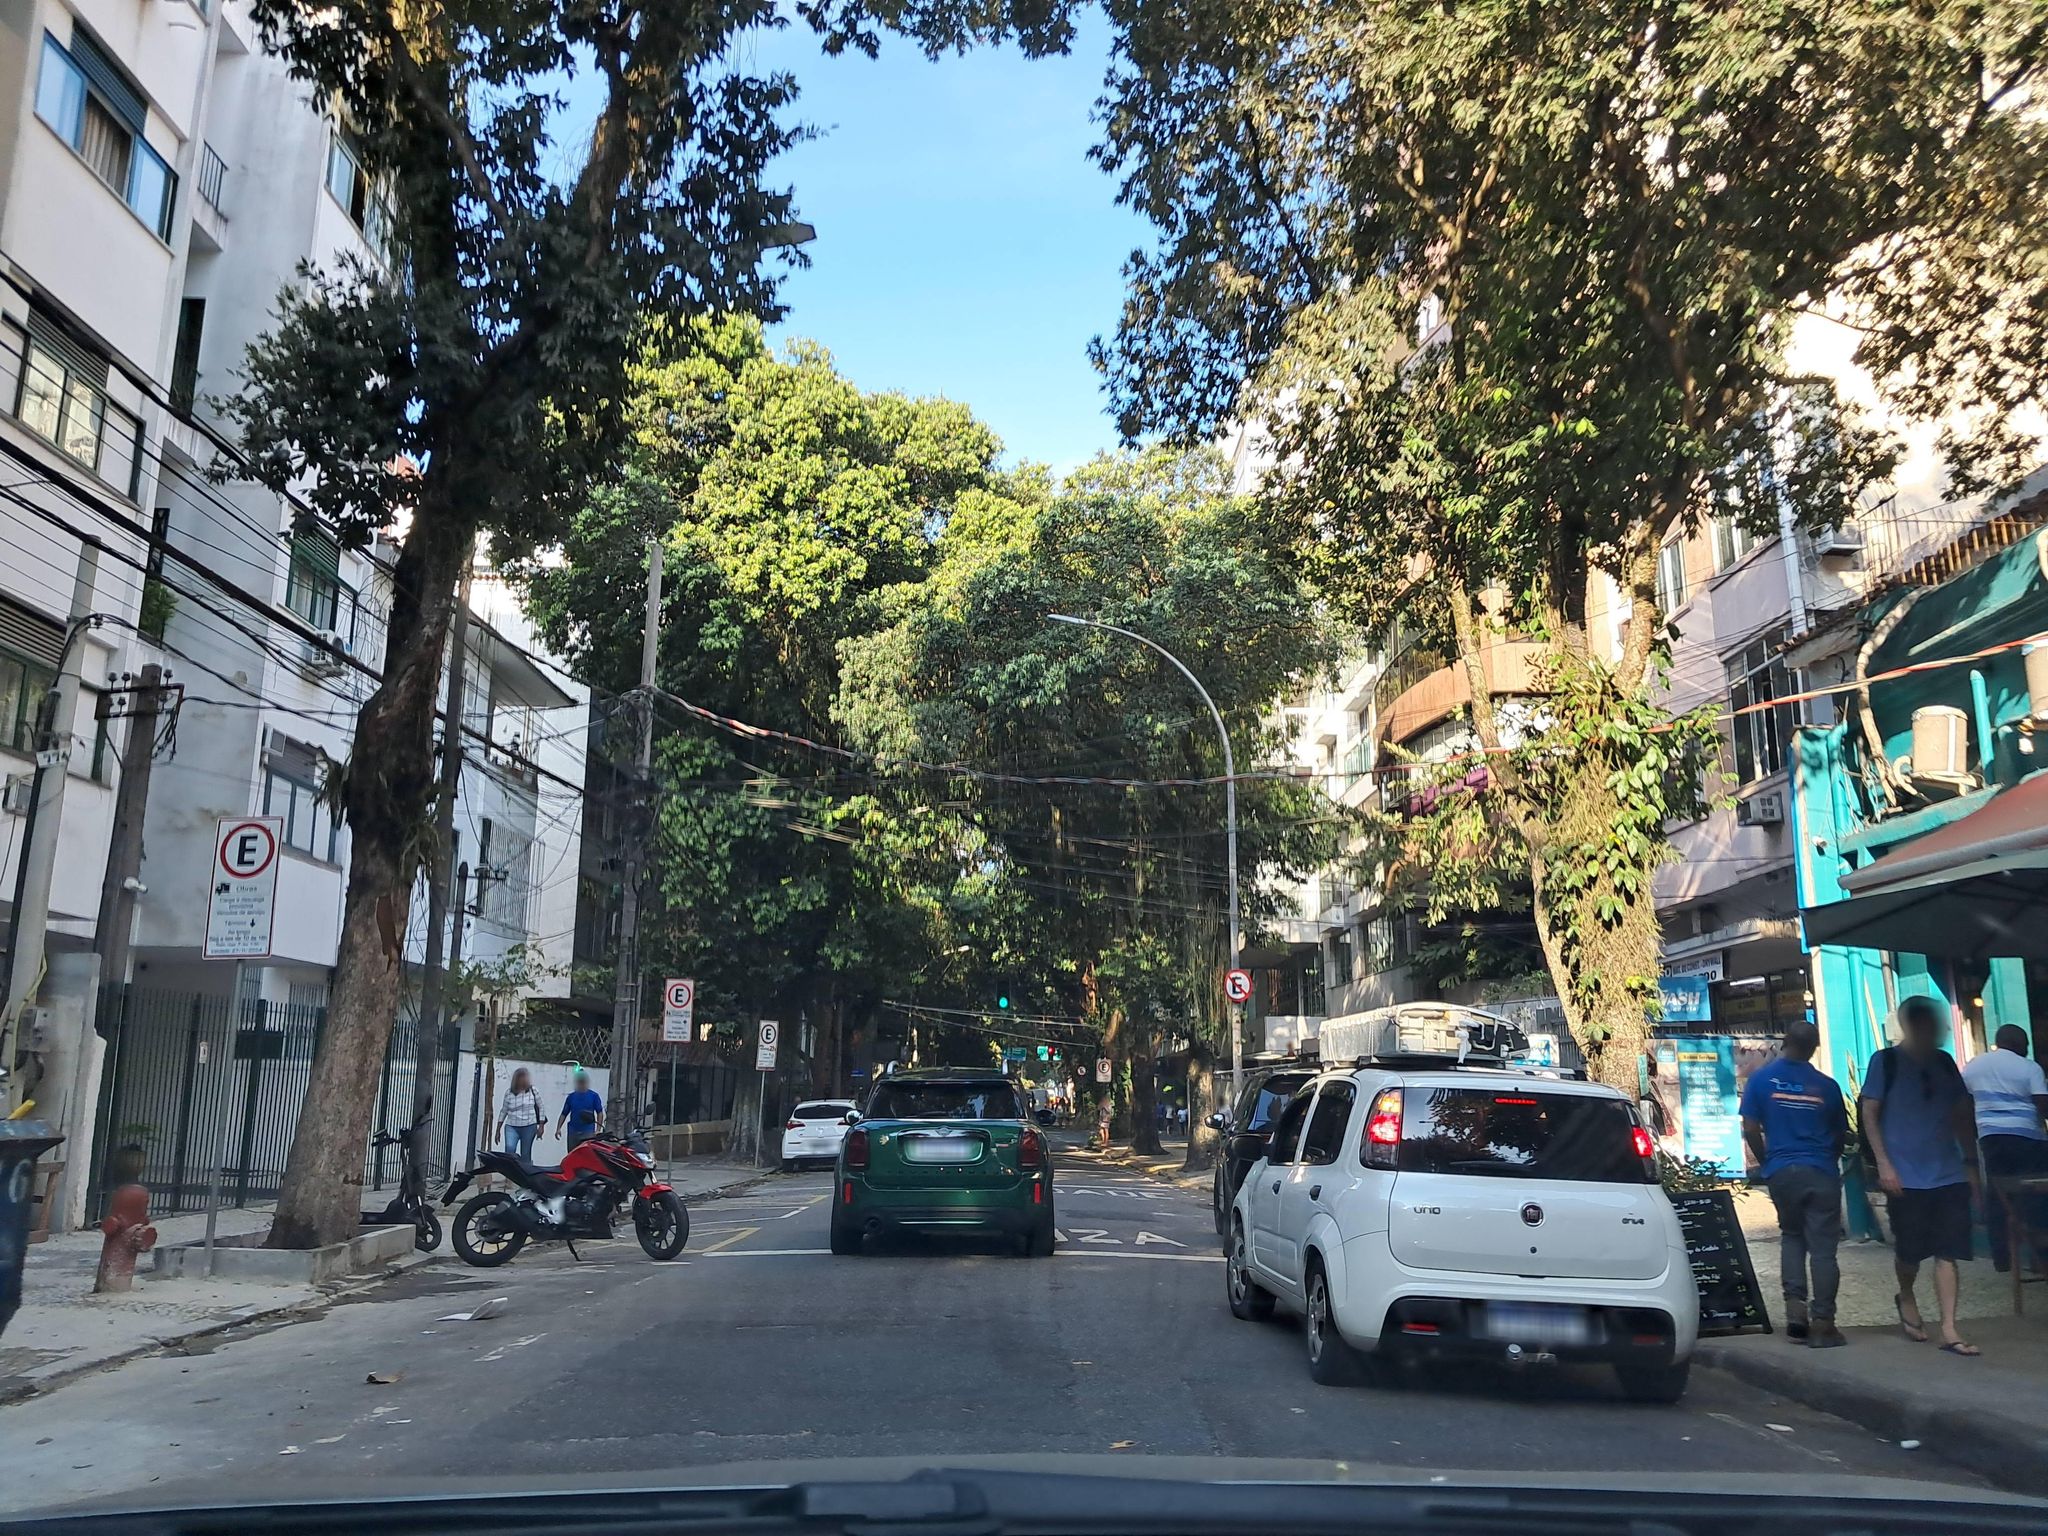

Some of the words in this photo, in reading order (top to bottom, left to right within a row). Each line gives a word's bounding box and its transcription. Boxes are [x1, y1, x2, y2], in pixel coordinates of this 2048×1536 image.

[237, 834, 258, 867] E
[674, 988, 684, 1003] E
[765, 1028, 772, 1040] E
